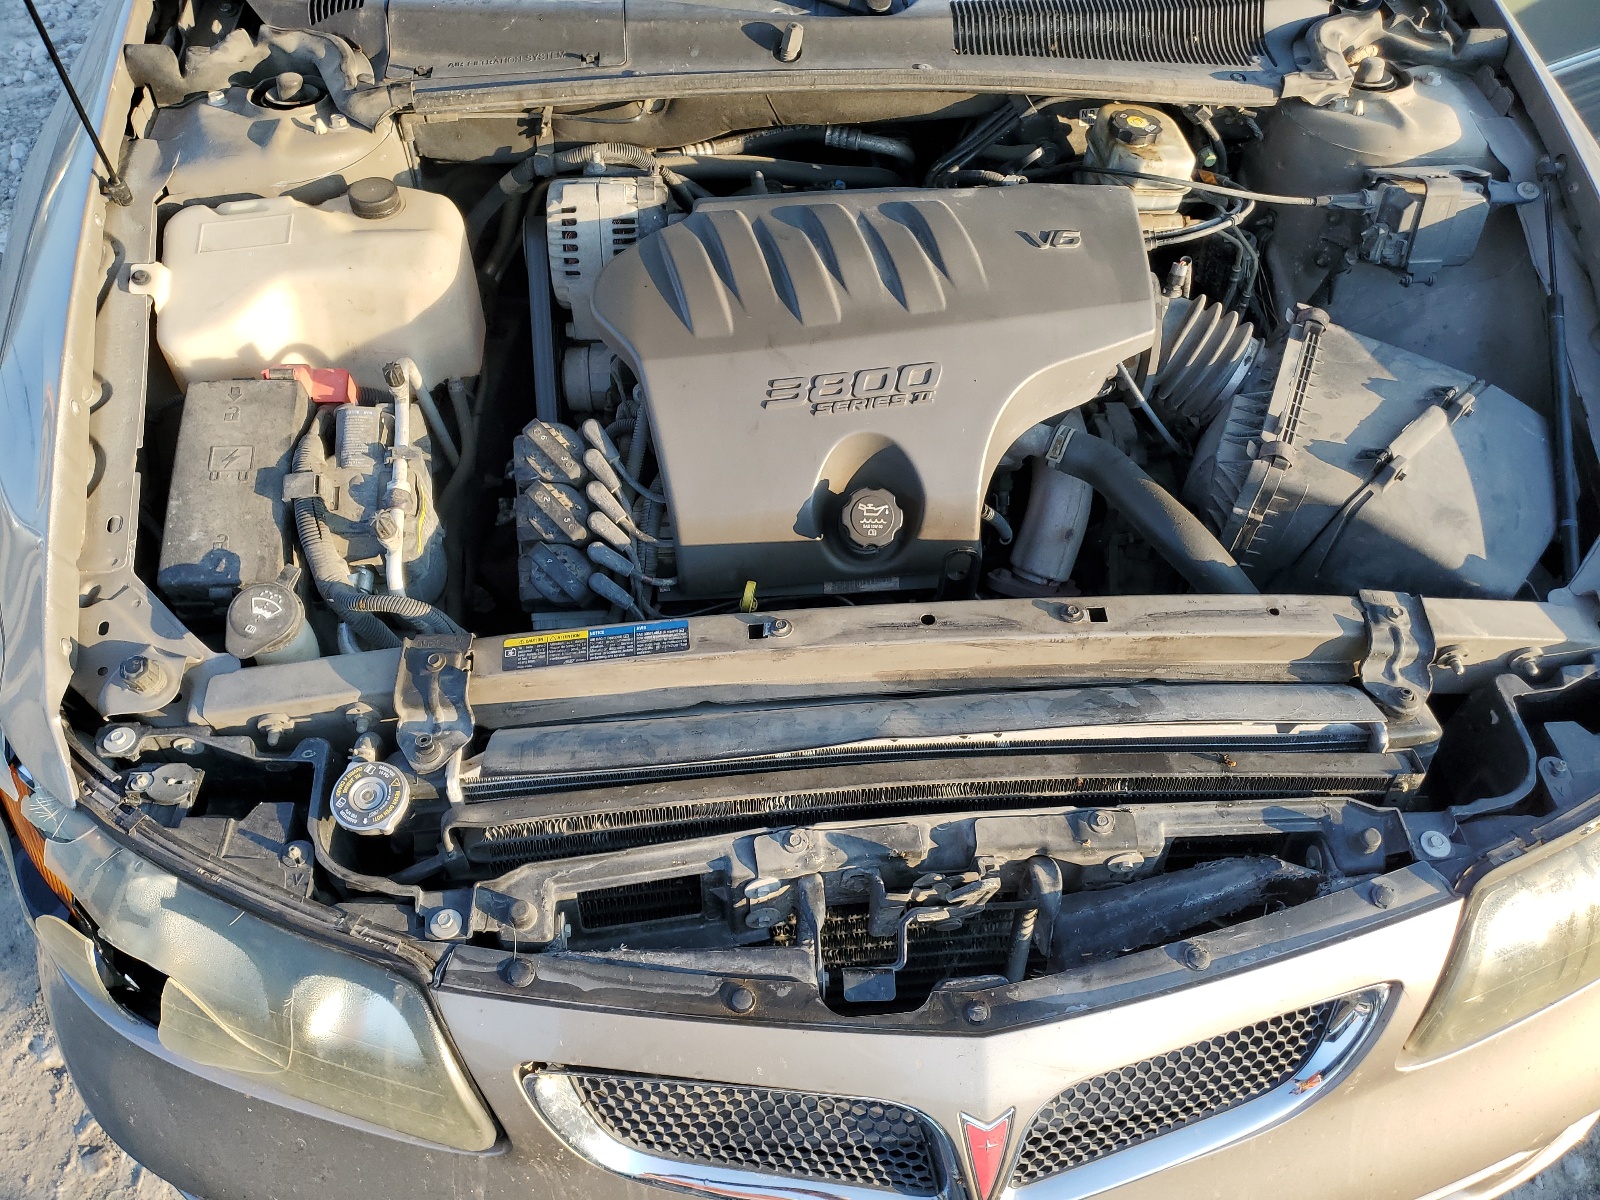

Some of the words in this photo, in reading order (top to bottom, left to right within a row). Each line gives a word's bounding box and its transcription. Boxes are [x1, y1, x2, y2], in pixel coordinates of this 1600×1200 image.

[525, 50, 567, 63] SYSTEM
[1014, 229, 1082, 250] V6
[760, 361, 943, 410] 3800
[810, 393, 908, 417] SERIES
